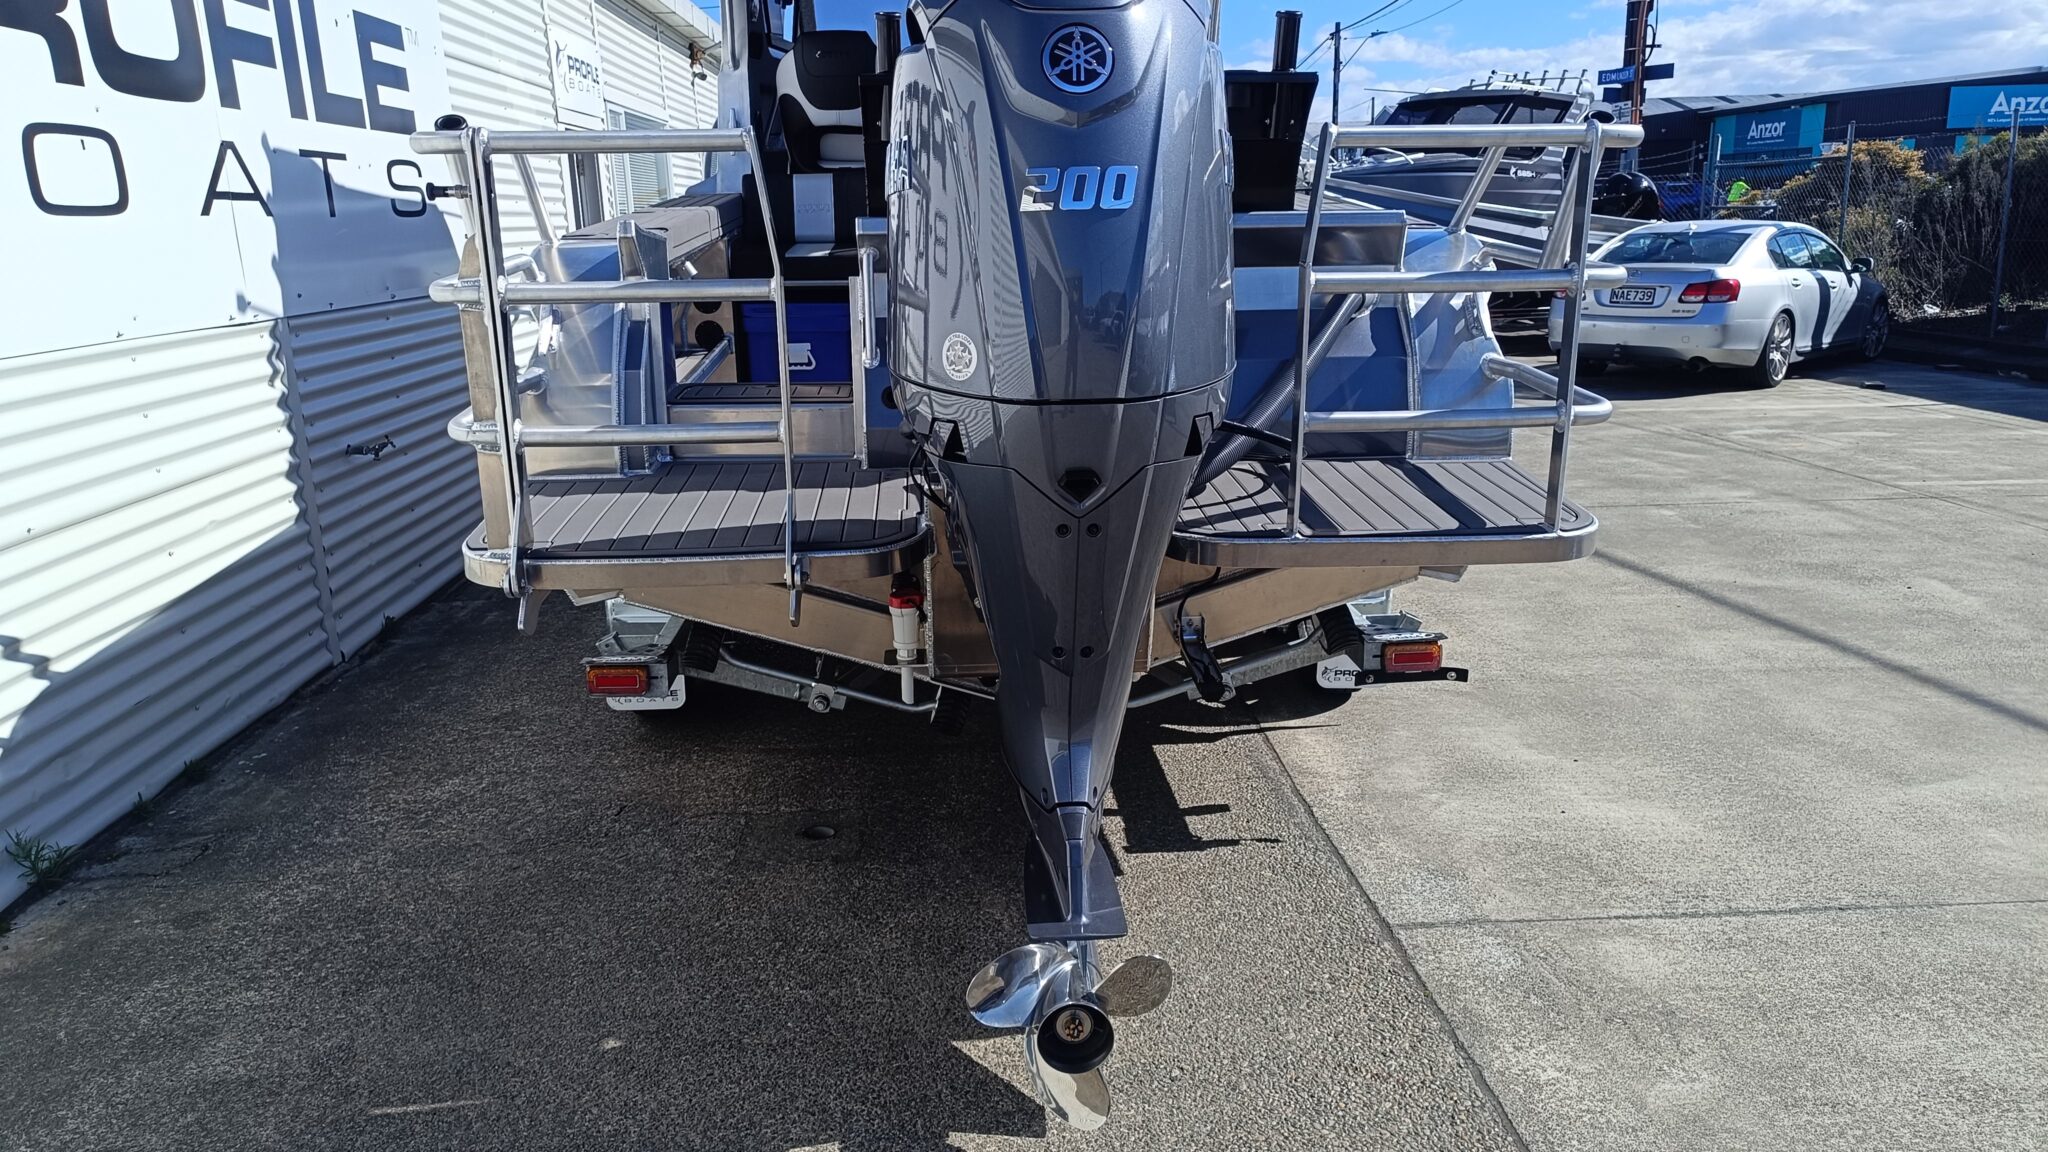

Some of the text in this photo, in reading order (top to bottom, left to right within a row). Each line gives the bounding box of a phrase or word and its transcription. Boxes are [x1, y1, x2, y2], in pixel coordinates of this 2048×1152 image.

[1747, 119, 1786, 140] Anzor
[1020, 165, 1138, 212] 200
[1611, 288, 1653, 302] NAE739
